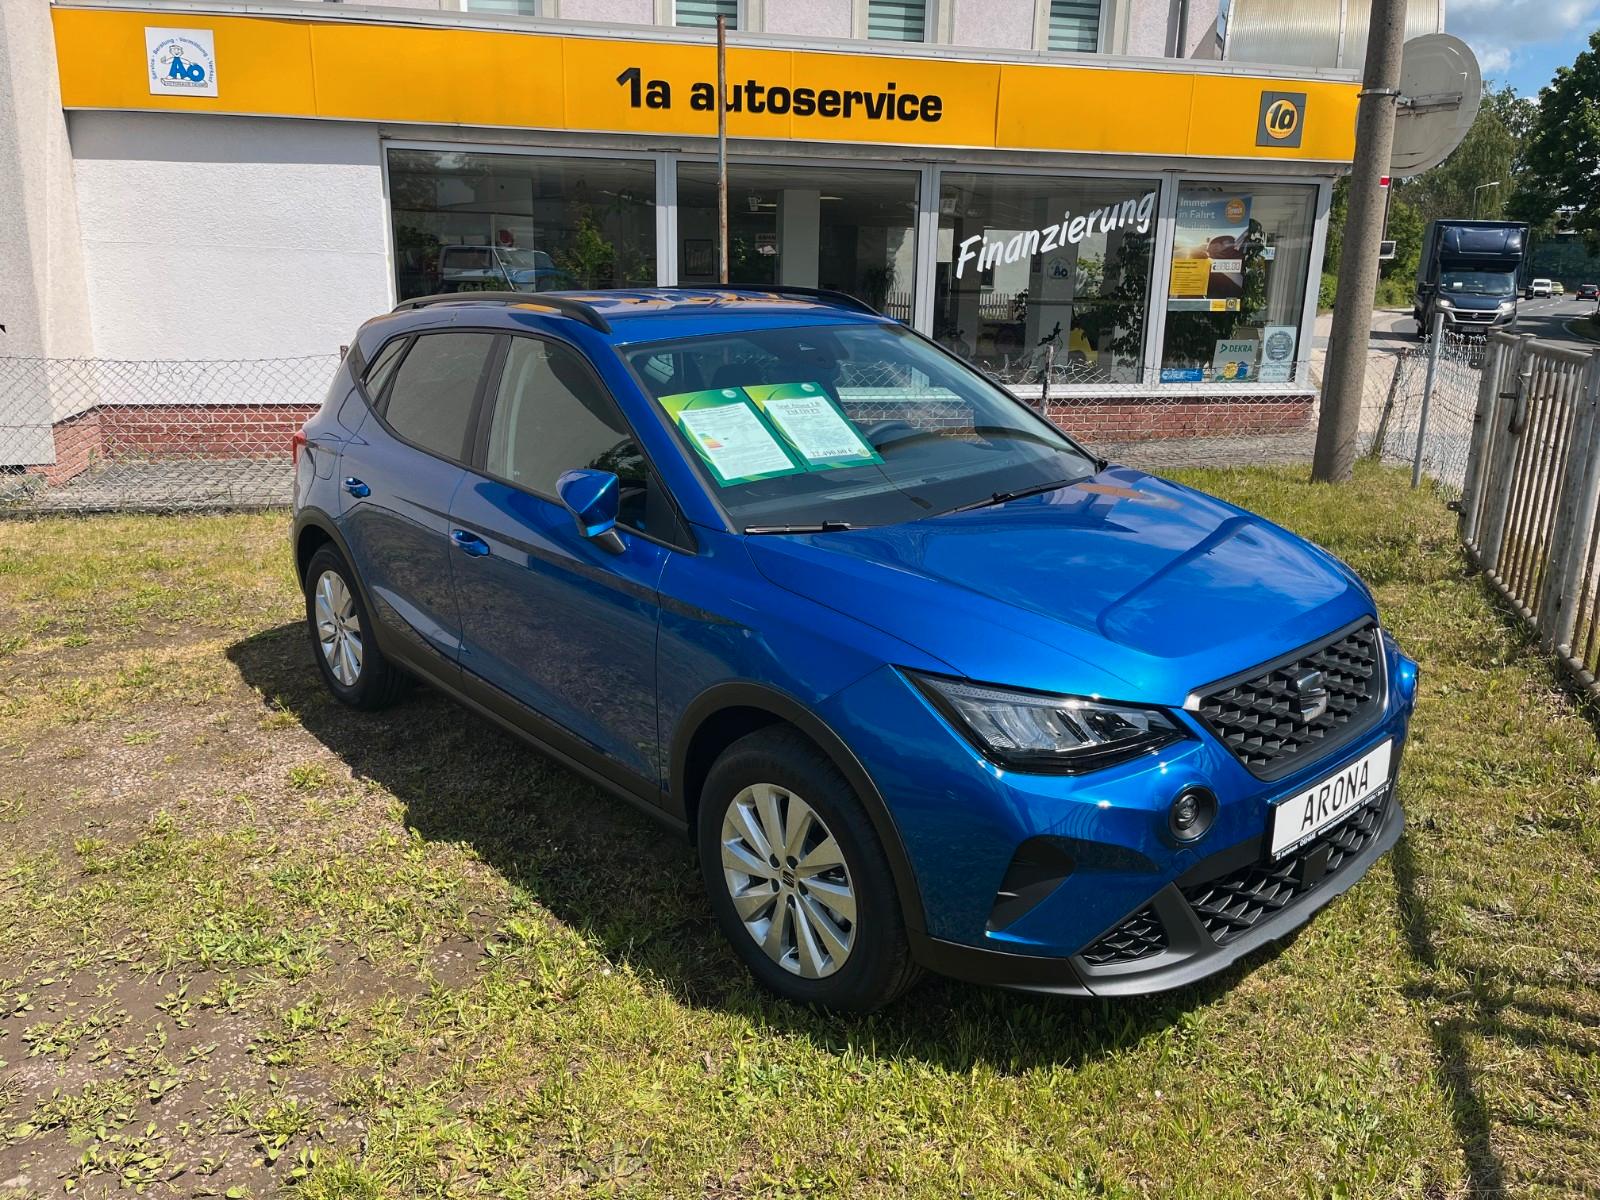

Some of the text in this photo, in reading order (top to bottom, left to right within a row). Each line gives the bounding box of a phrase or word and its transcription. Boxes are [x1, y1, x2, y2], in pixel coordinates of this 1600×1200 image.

[616, 67, 943, 122] 1a autoservice
[1269, 103, 1295, 130] 1a
[1180, 197, 1210, 207] Immer
[1190, 209, 1216, 219] Fahrt
[956, 191, 1156, 280] Finanzierung
[1228, 344, 1253, 353] DEKRA
[1301, 759, 1369, 831] ARONA
